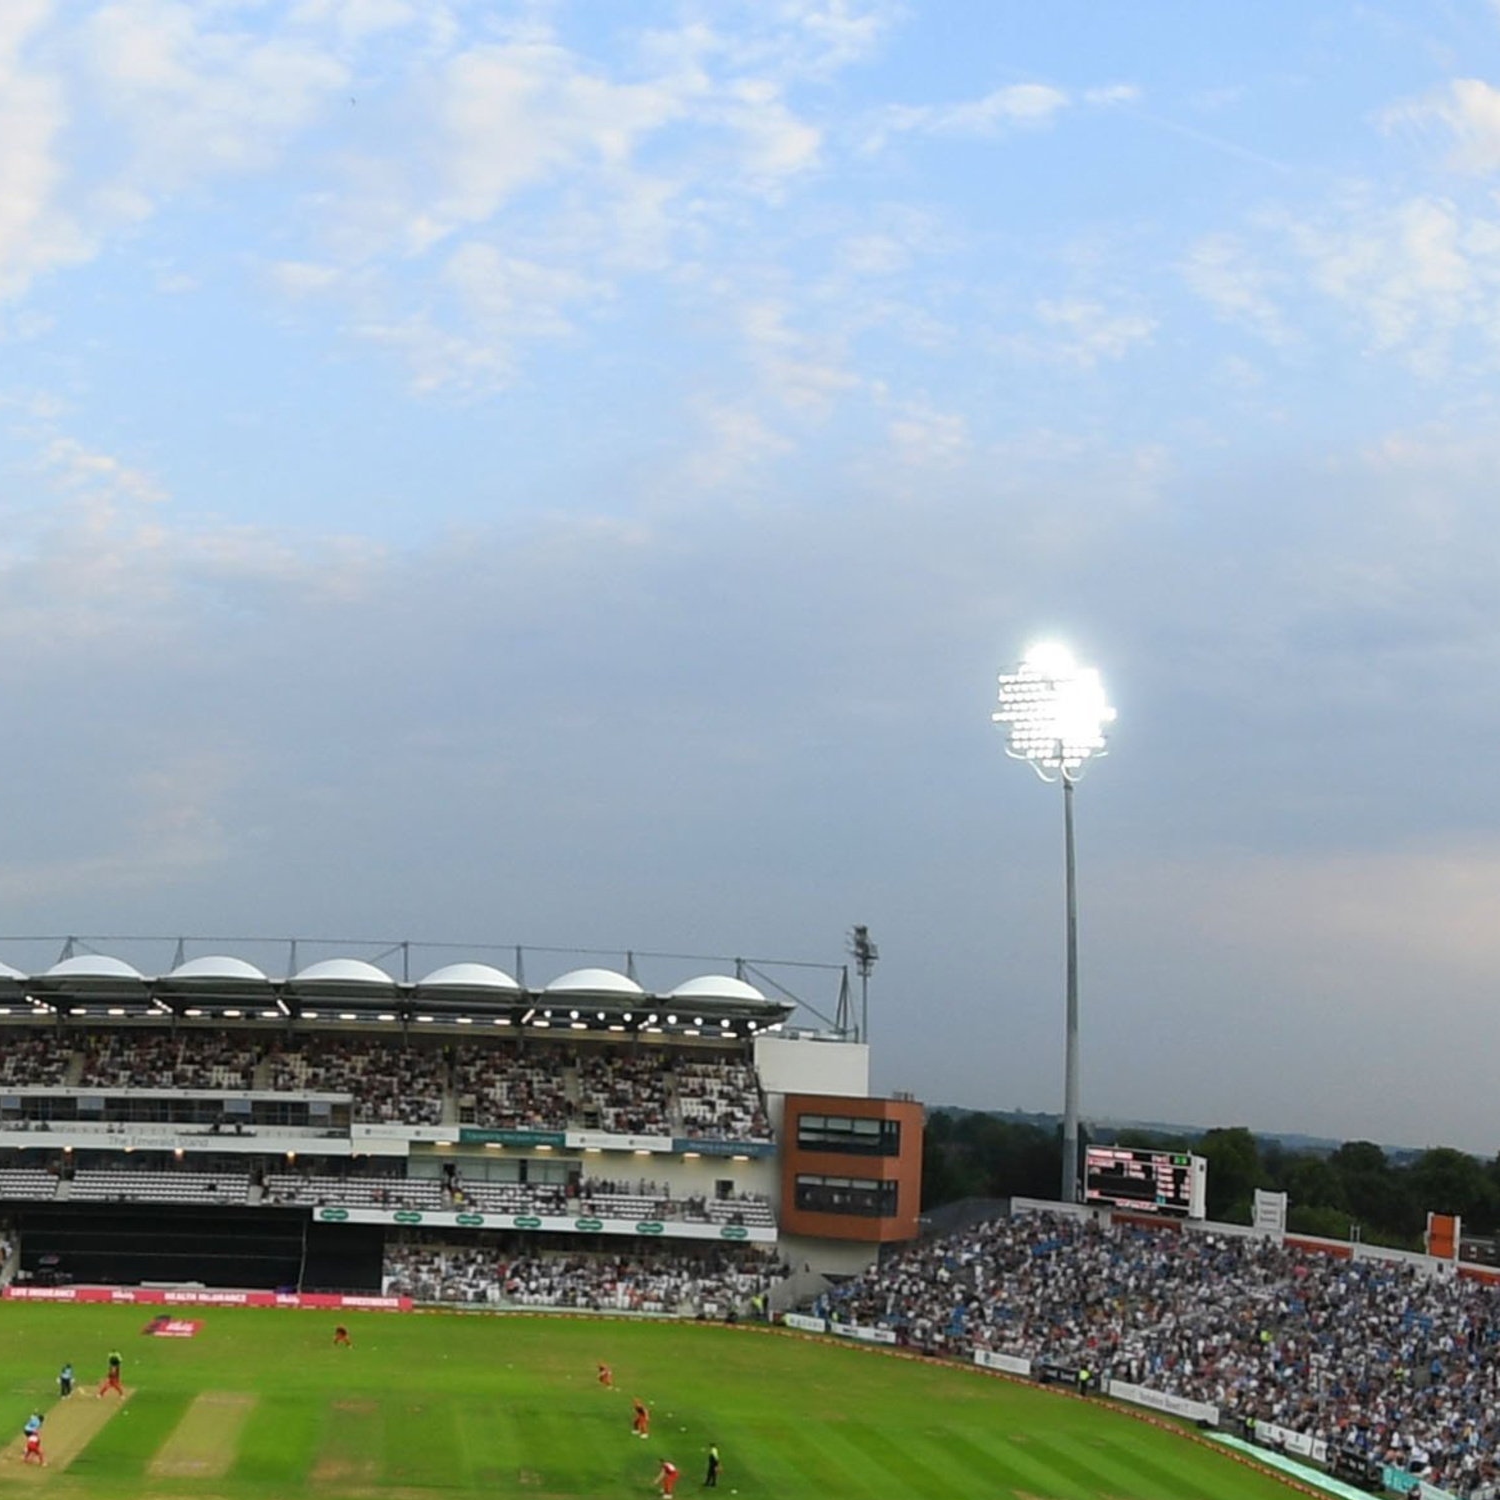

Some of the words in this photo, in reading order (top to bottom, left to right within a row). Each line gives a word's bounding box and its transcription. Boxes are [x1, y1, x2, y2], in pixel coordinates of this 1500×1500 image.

[131, 1136, 174, 1147] Emerald
[179, 1138, 209, 1148] Stand
[10, 1287, 27, 1297] LIFE
[28, 1288, 76, 1298] INSURANCE
[164, 1292, 197, 1302] HEALTH
[198, 1293, 247, 1303] INSURANCE
